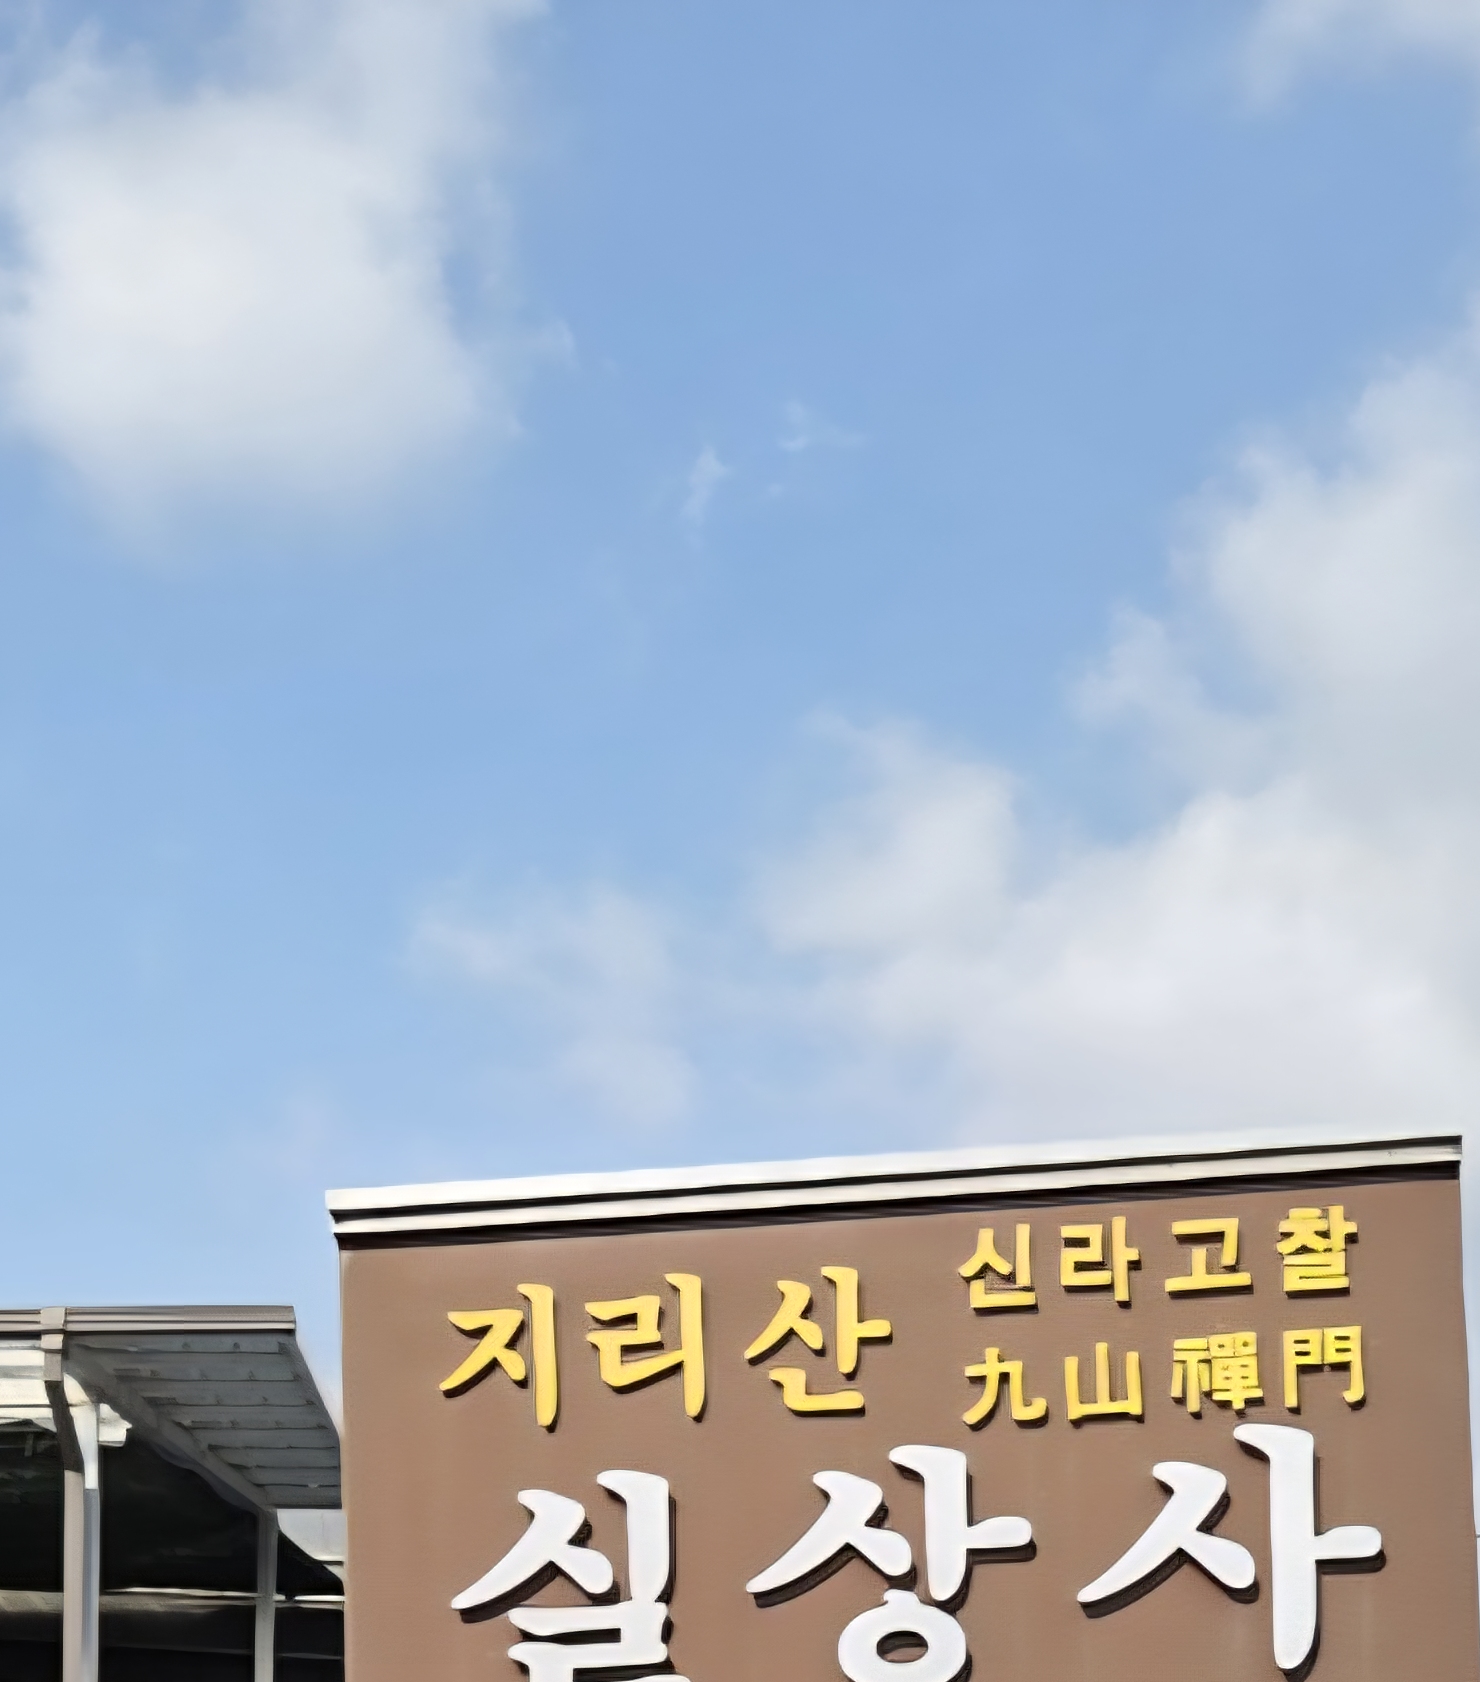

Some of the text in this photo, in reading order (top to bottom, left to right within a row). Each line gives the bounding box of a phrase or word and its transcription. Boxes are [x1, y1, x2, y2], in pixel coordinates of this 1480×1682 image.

[958, 1205, 1358, 1310] 신라고찰
[439, 1266, 893, 1430] 지리산
[961, 1325, 1367, 1428] 九山禪門
